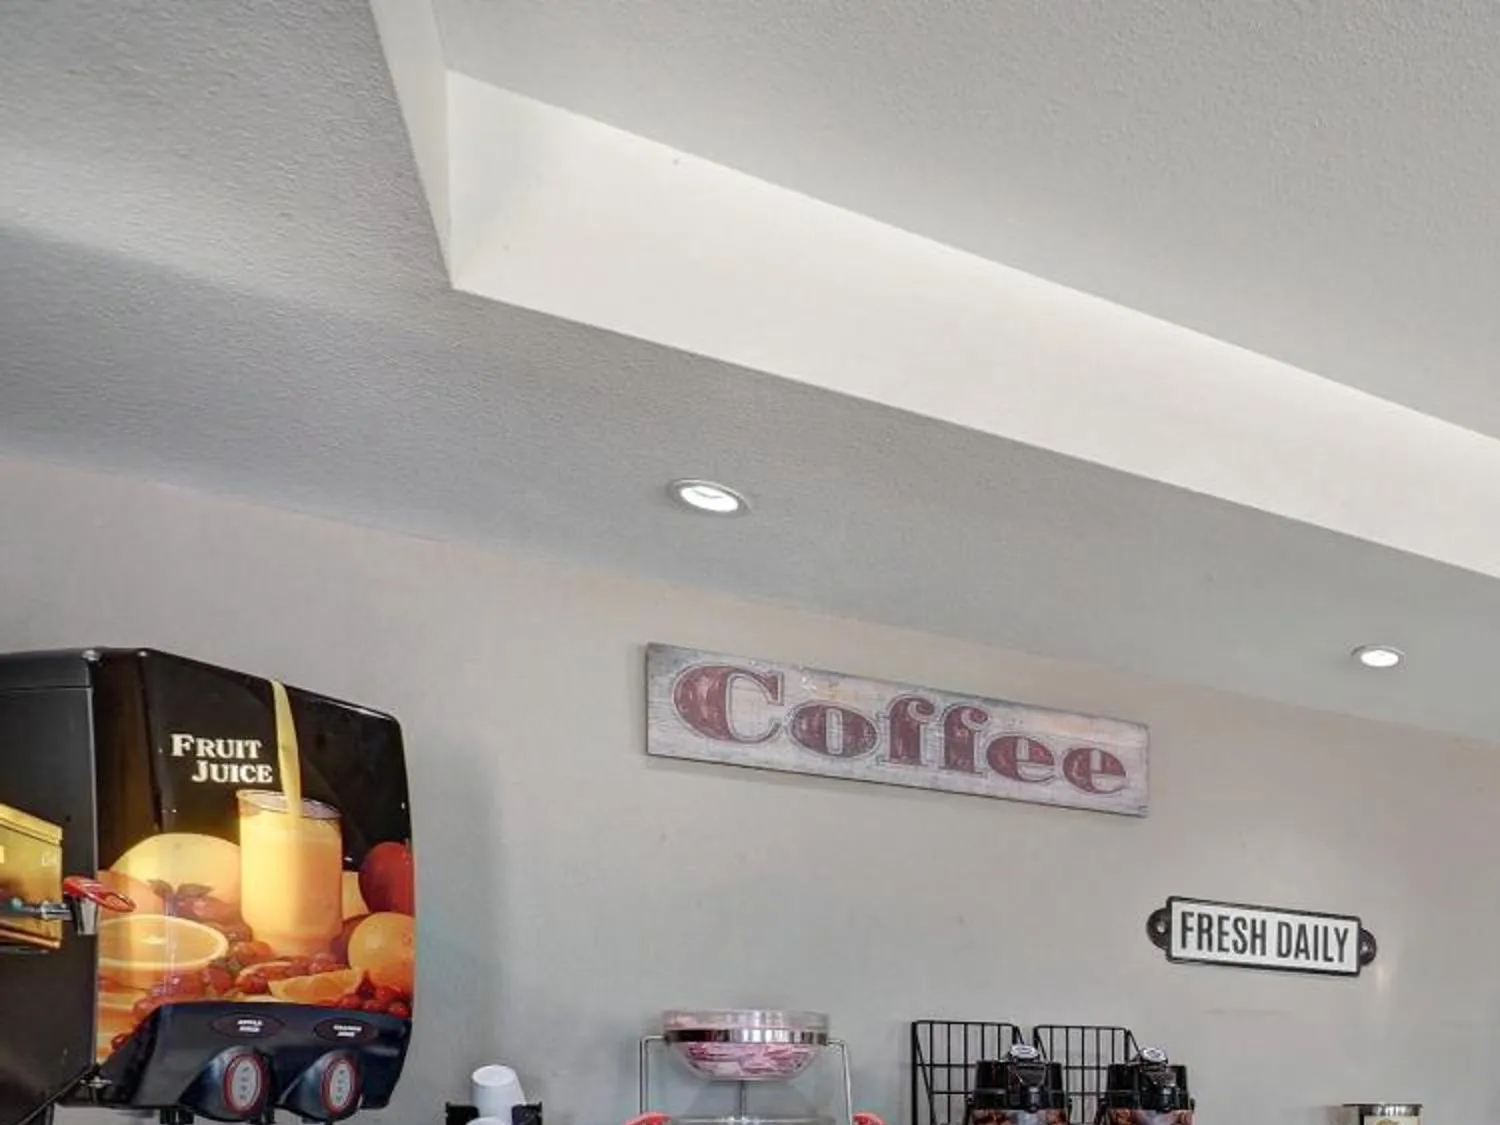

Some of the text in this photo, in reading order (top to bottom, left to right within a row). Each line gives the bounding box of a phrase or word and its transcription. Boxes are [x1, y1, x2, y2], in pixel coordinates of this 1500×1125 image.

[170, 733, 262, 759] FRUIT
[673, 663, 1129, 796] Coffee
[191, 759, 273, 783] JUICE
[1180, 911, 1350, 963] FRESH DAILY
